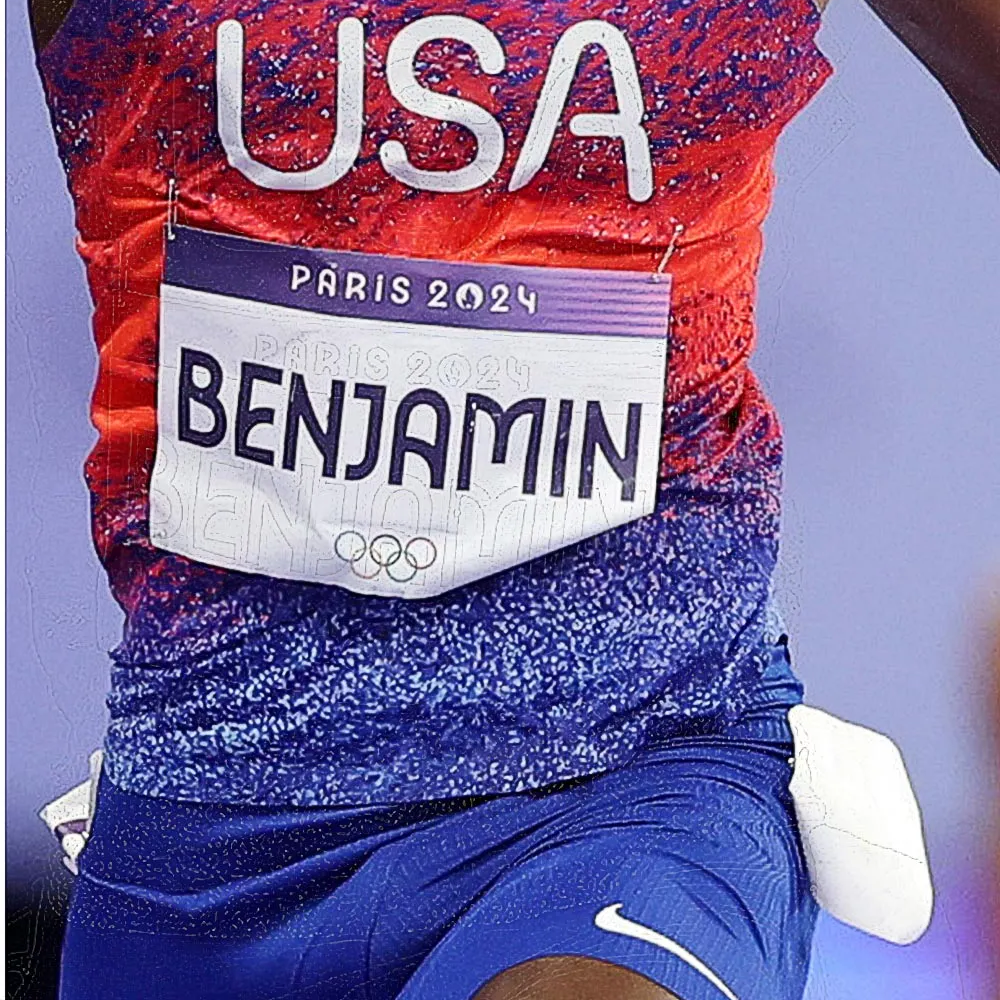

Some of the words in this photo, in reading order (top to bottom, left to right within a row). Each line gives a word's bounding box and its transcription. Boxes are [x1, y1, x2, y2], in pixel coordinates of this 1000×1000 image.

[216, 15, 653, 202] USA
[291, 263, 410, 304] PARIS
[427, 279, 538, 314] 2024
[178, 346, 642, 502] BENJAMIN
